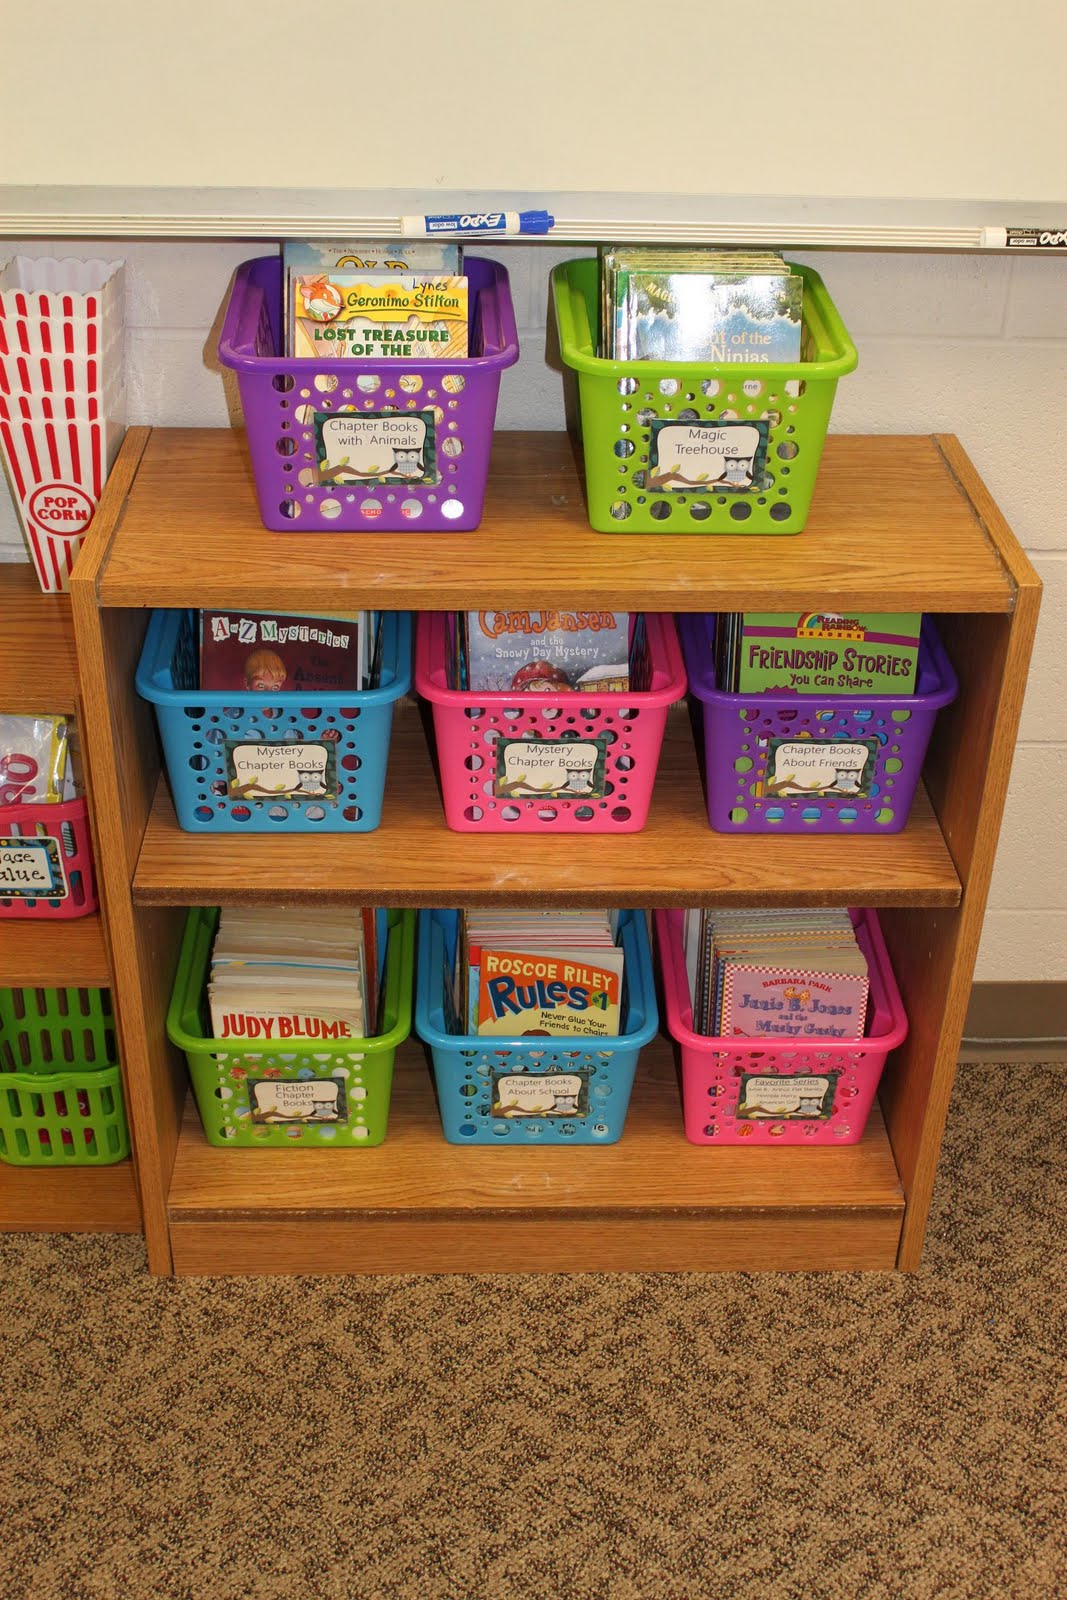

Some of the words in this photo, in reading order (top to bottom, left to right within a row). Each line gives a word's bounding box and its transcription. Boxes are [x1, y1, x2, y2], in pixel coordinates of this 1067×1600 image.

[459, 211, 502, 229] EXPO
[412, 277, 448, 293] Lynes
[347, 292, 410, 307] Geronimo
[413, 293, 459, 308] Stilton
[314, 328, 356, 342] LOST
[362, 329, 449, 342] TREASURE
[731, 332, 748, 345] of
[749, 332, 772, 345] the
[351, 343, 374, 356] OF
[381, 344, 412, 356] THE
[329, 421, 379, 433] Chapter
[382, 421, 418, 432] Books
[338, 436, 363, 446] with
[369, 435, 417, 446] Animals
[688, 429, 727, 443] Magic
[675, 444, 739, 455] Treehouse
[44, 496, 78, 509] POP
[37, 508, 88, 521] CORN
[532, 610, 617, 632] Jansen
[817, 615, 860, 625] READING
[214, 618, 229, 638] A
[240, 621, 254, 641] Z
[822, 623, 865, 632] RAINBOW
[530, 636, 546, 646] and
[549, 635, 564, 645] the
[799, 631, 862, 639] READERS
[495, 647, 529, 661] Snowy
[532, 646, 552, 660] Day
[555, 646, 599, 660] Mystery
[790, 673, 810, 687] You
[814, 674, 835, 687] Can
[838, 673, 873, 688] Share
[257, 747, 304, 758] Mystery
[526, 745, 573, 756] Mystery
[782, 745, 826, 756] Chapter
[829, 746, 862, 755] Books
[237, 760, 285, 772] Chapter
[288, 760, 324, 769] Books
[508, 756, 555, 768] Chapter
[558, 758, 593, 768] Books
[782, 758, 816, 767] About
[819, 759, 858, 768] Friends
[0, 867, 46, 882] alue
[486, 955, 557, 979] ROSCOE
[563, 970, 613, 991] RILEY
[762, 978, 806, 988] BARBARA
[808, 980, 833, 993] PARK
[739, 994, 784, 1011] Junie
[787, 997, 805, 1012] B.
[808, 999, 852, 1016] Jones
[541, 1011, 567, 1022] Never
[567, 1016, 586, 1025] Glue
[587, 1019, 607, 1029] Your
[778, 1013, 793, 1021] and
[221, 1013, 274, 1039] JUDY
[278, 1015, 352, 1039] BLUME
[539, 1020, 570, 1031] Friends
[573, 1025, 582, 1033] to
[583, 1027, 609, 1037] Chairs
[755, 1020, 802, 1036] Mushy
[275, 1084, 314, 1093] Fiction
[505, 1078, 542, 1087] Chapter
[545, 1078, 572, 1086] Books
[275, 1092, 315, 1100] Chapter
[283, 1099, 313, 1107] Books
